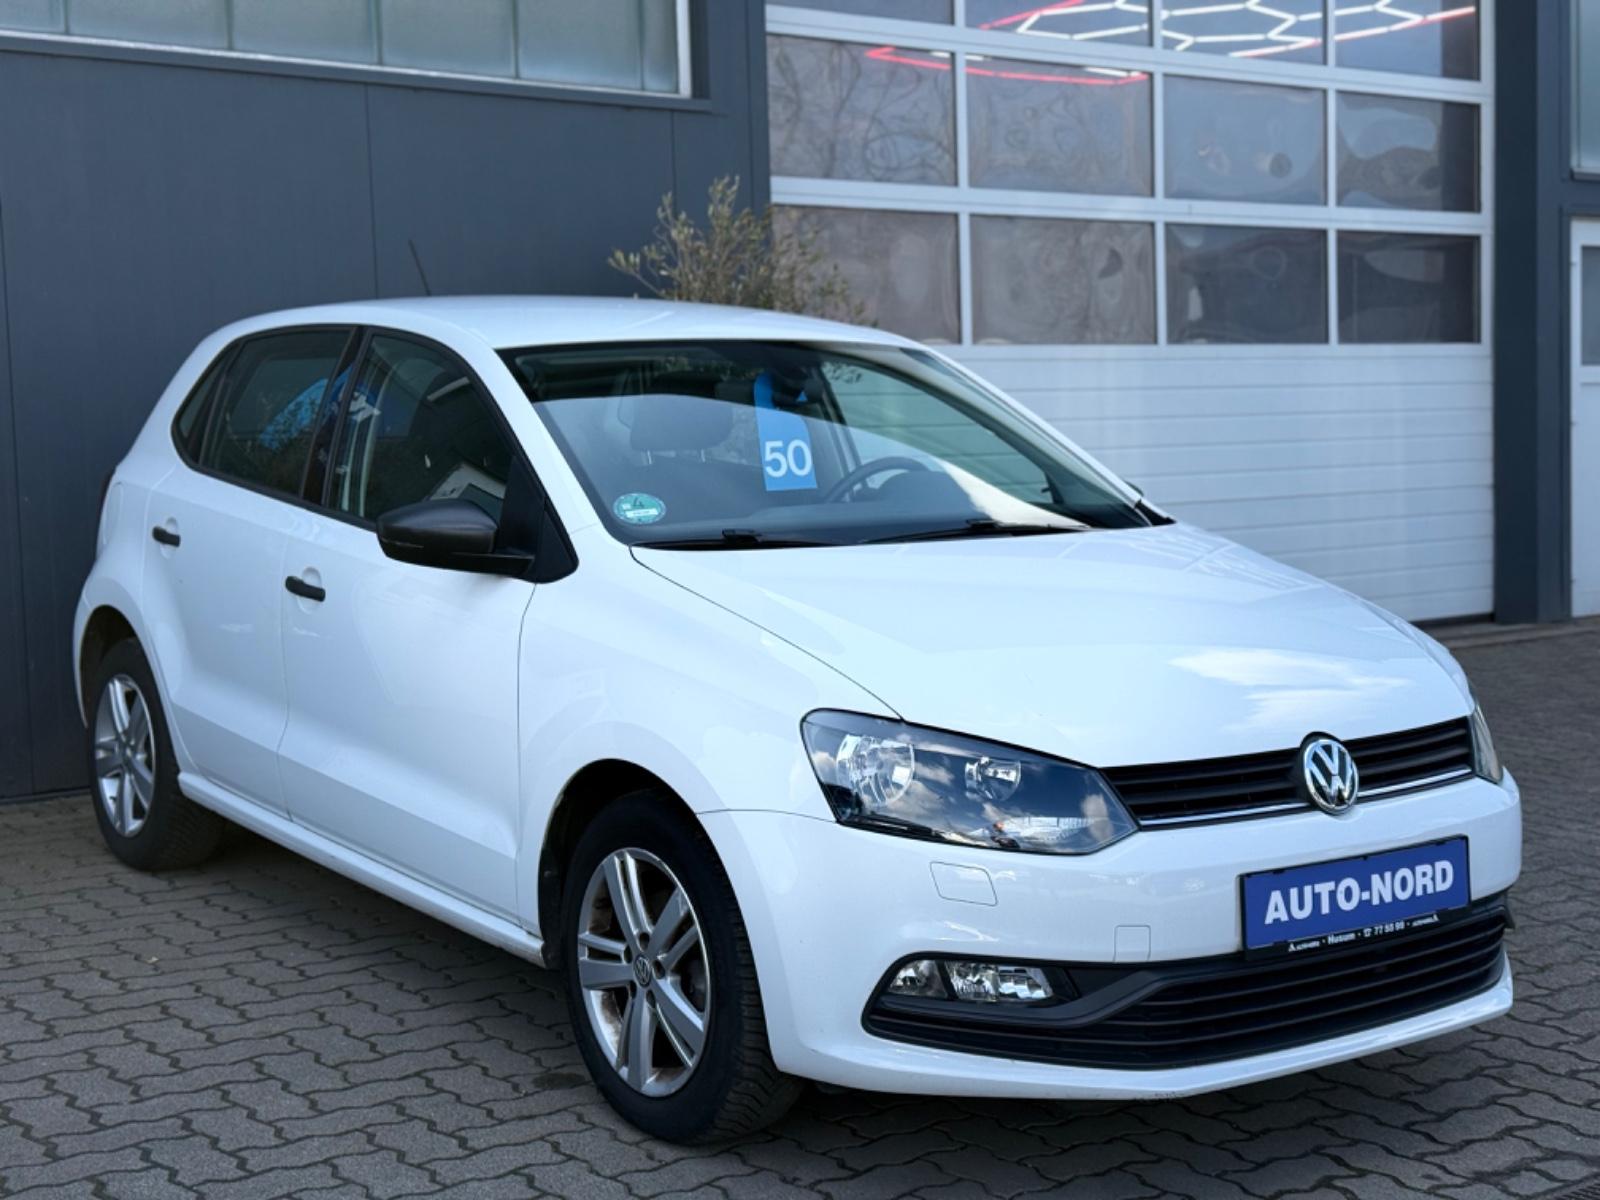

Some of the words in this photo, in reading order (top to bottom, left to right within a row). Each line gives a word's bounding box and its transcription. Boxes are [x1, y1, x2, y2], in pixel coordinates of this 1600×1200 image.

[763, 439, 812, 478] 50
[1304, 739, 1357, 809] VW
[1264, 860, 1454, 925] AUTO-NORD
